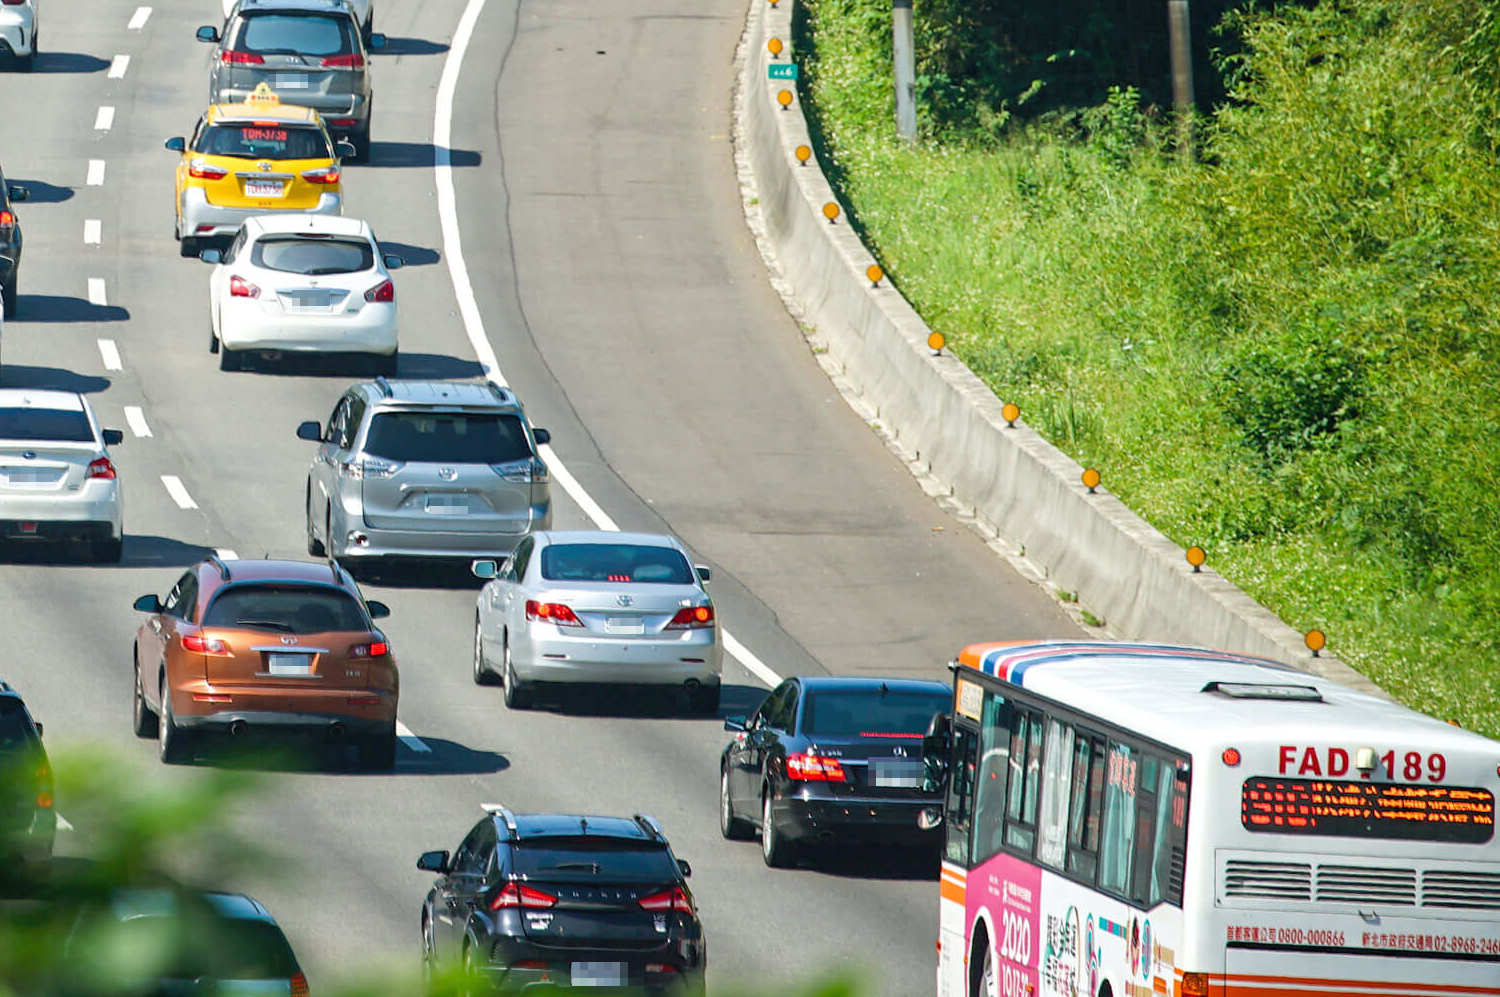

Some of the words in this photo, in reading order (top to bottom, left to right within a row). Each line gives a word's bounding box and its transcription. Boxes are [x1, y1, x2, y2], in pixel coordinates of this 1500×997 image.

[1001, 913, 1030, 966] 2020
[1278, 928, 1345, 946] 0800-000866
[1434, 937, 1500, 955] 02-8968-246
